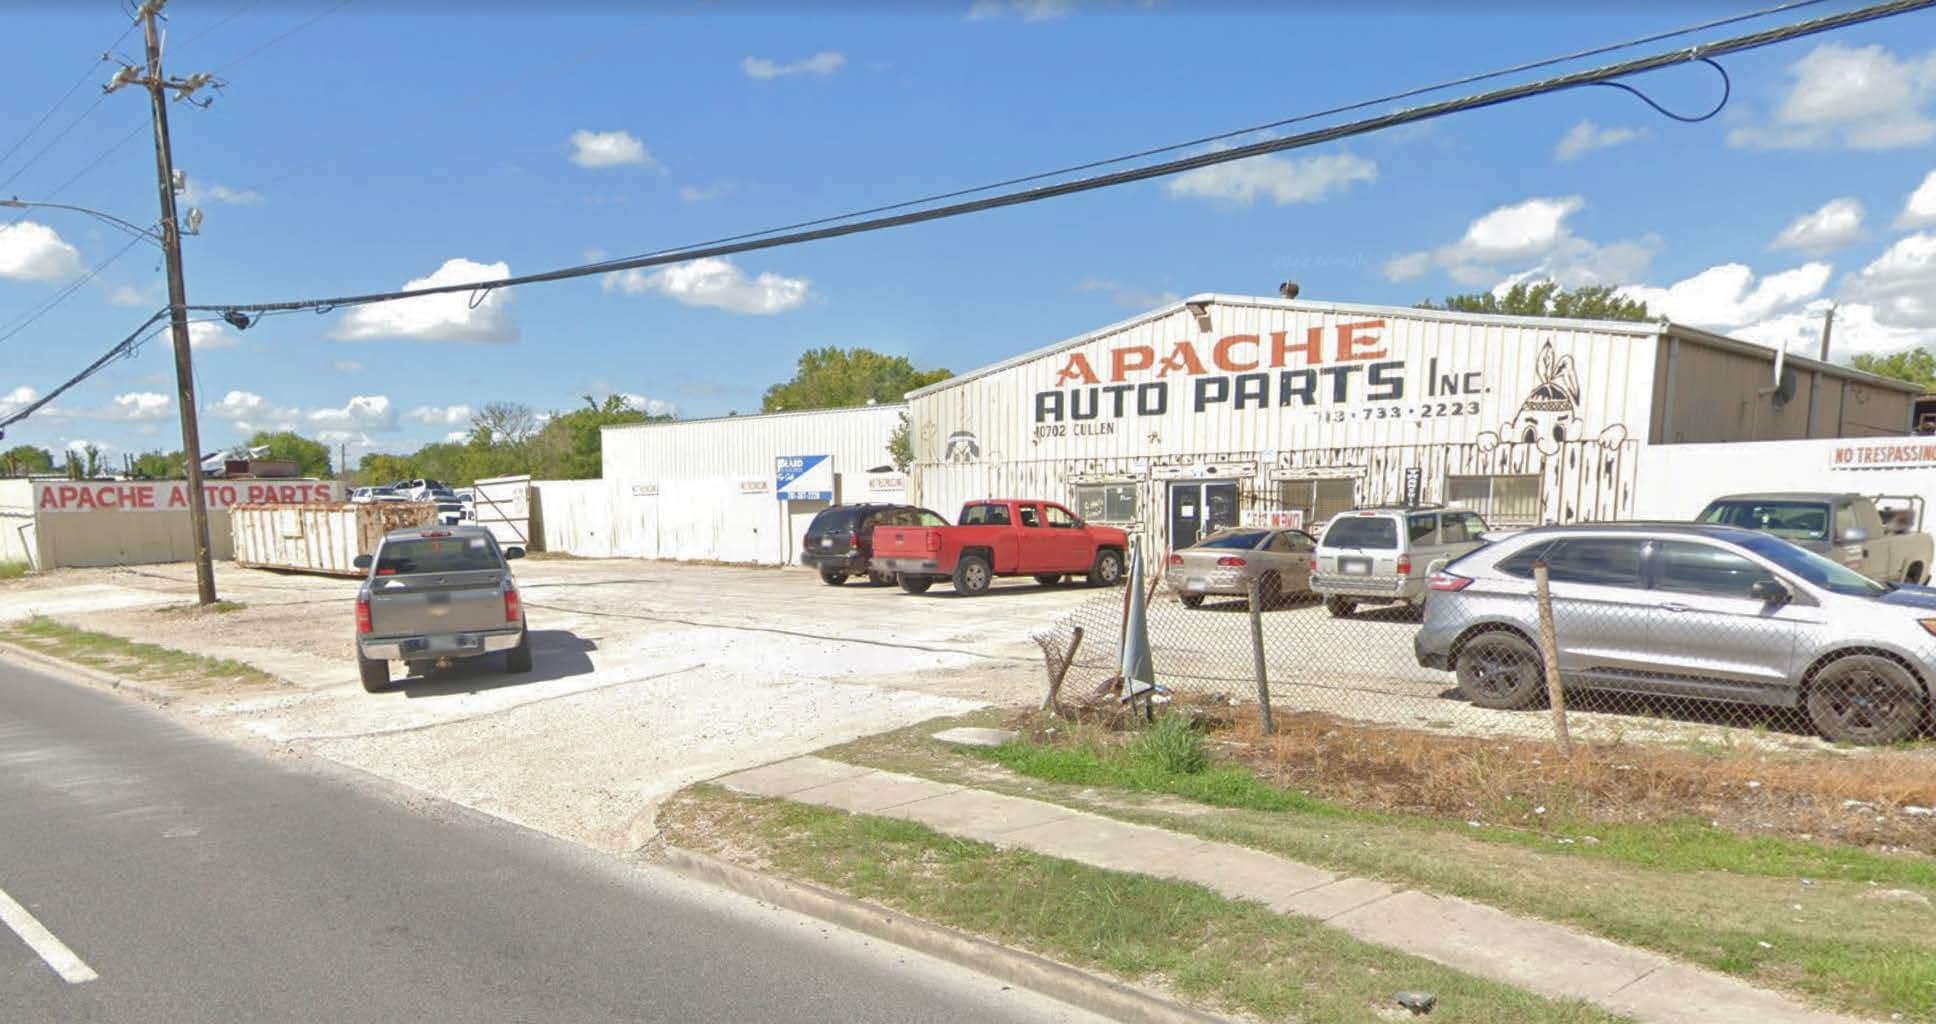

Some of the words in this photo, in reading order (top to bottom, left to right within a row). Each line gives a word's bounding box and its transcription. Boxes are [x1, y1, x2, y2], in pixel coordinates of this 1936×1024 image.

[1055, 319, 1388, 388] APACHE
[1035, 381, 1168, 423] AUTO
[1194, 360, 1405, 413] PARTS
[1073, 422, 1115, 436] CULLEN
[1835, 447, 1853, 464] NO
[40, 484, 155, 509] APACHE
[168, 485, 238, 508] ATO
[248, 483, 332, 504] PARTS
